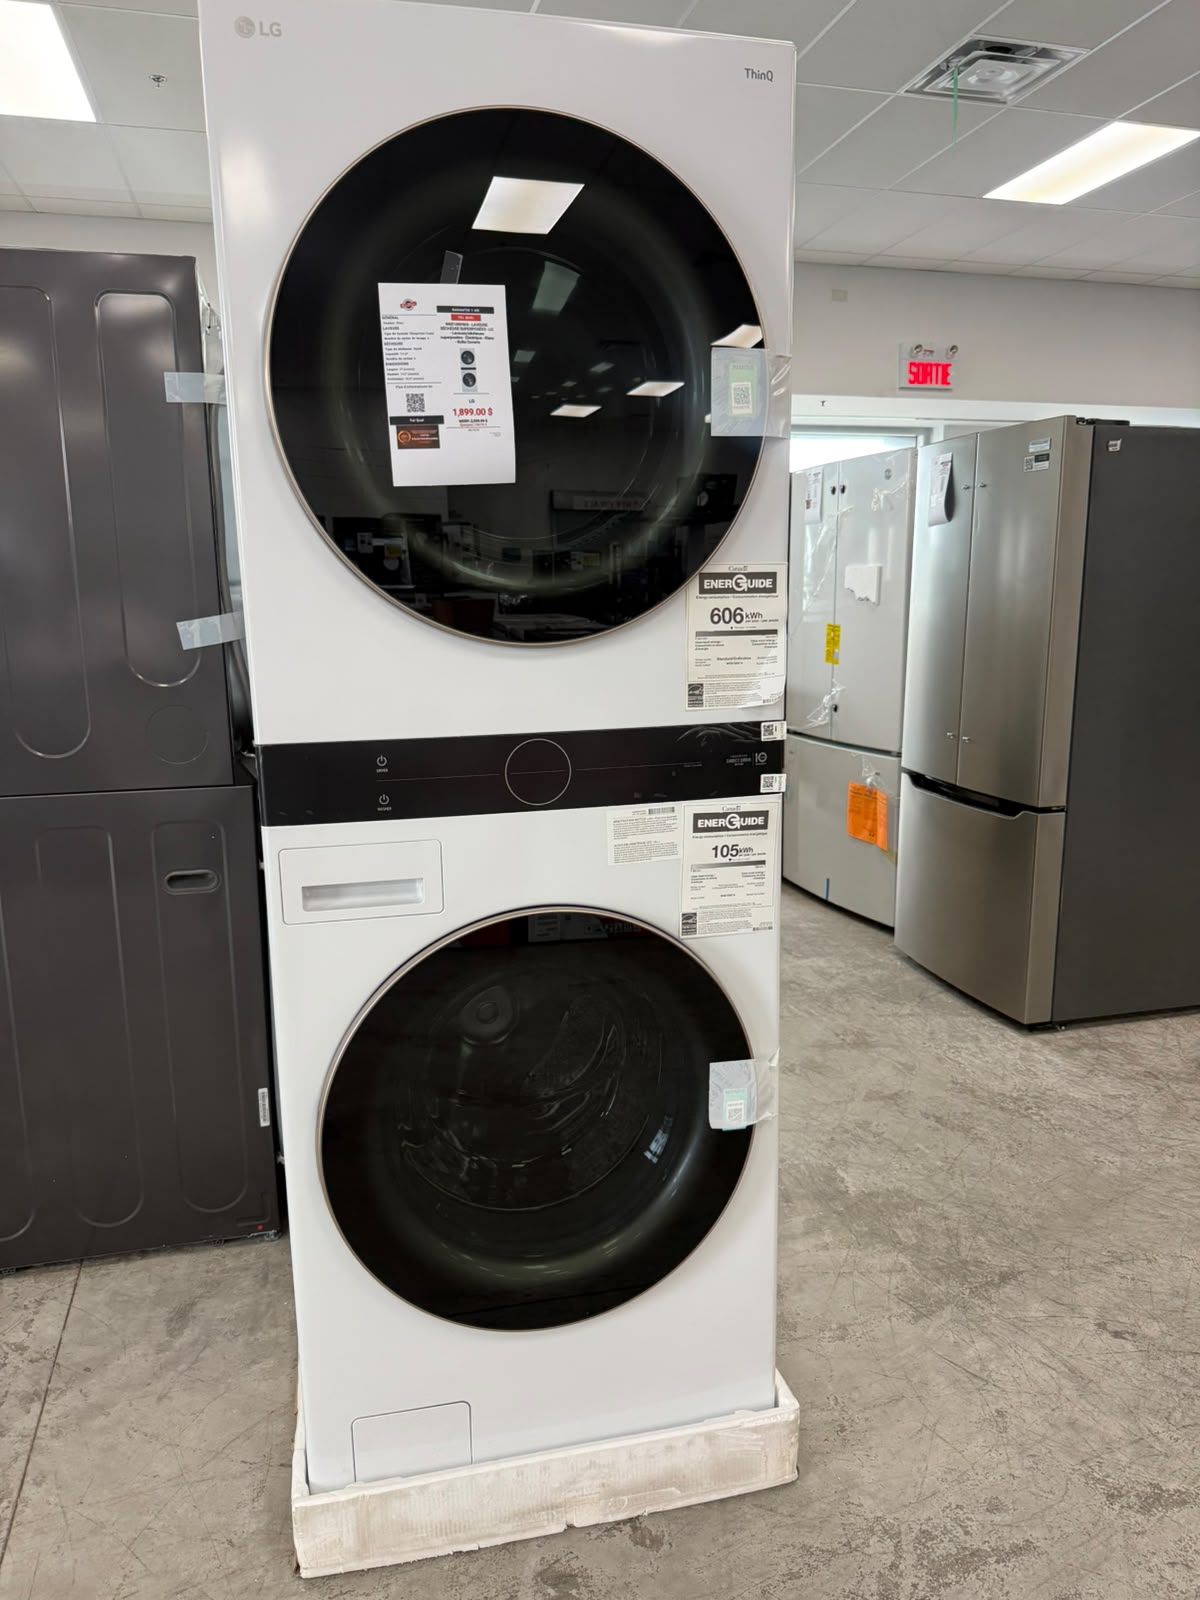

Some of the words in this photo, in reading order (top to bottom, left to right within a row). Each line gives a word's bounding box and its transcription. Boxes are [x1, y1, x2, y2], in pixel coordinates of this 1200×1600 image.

[259, 21, 282, 37] LG
[744, 67, 774, 82] ThinQ
[453, 408, 487, 417] 1,899.00
[487, 407, 493, 416] $
[703, 574, 773, 592] ENERGUIDE
[710, 607, 744, 625] 606
[745, 612, 763, 620] kWh
[697, 813, 765, 830] ENERGUIDE
[712, 844, 739, 859] 105
